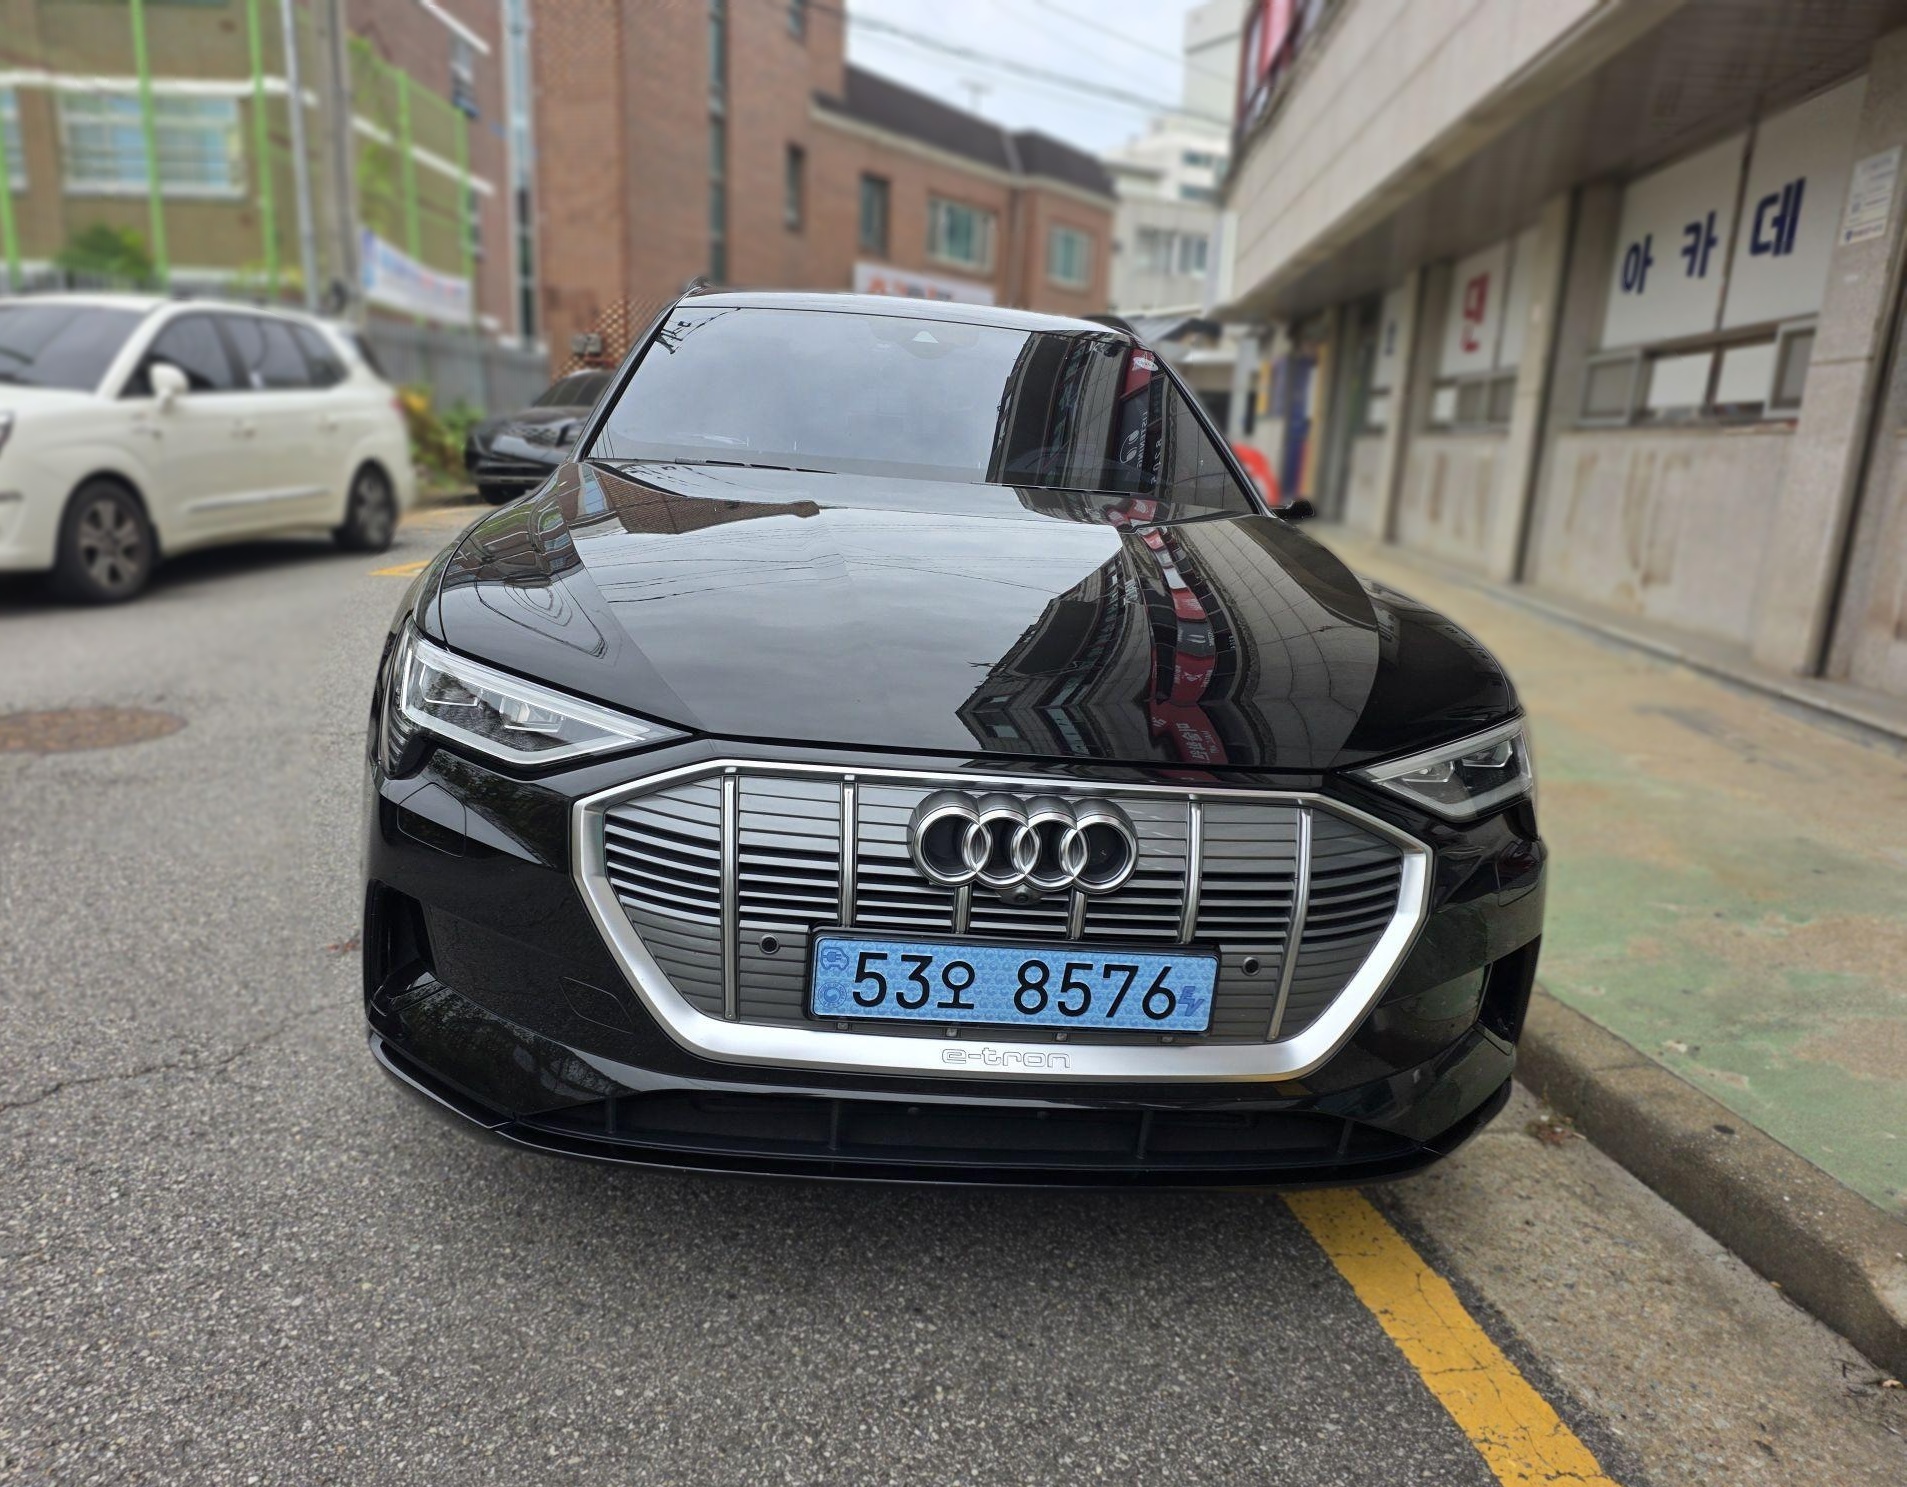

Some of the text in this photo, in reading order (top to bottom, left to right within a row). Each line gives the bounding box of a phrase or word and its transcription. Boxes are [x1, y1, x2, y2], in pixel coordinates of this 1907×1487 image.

[852, 952, 977, 1010] 53오
[1013, 958, 1177, 1021] 8576
[941, 1046, 1071, 1069] e-tron
